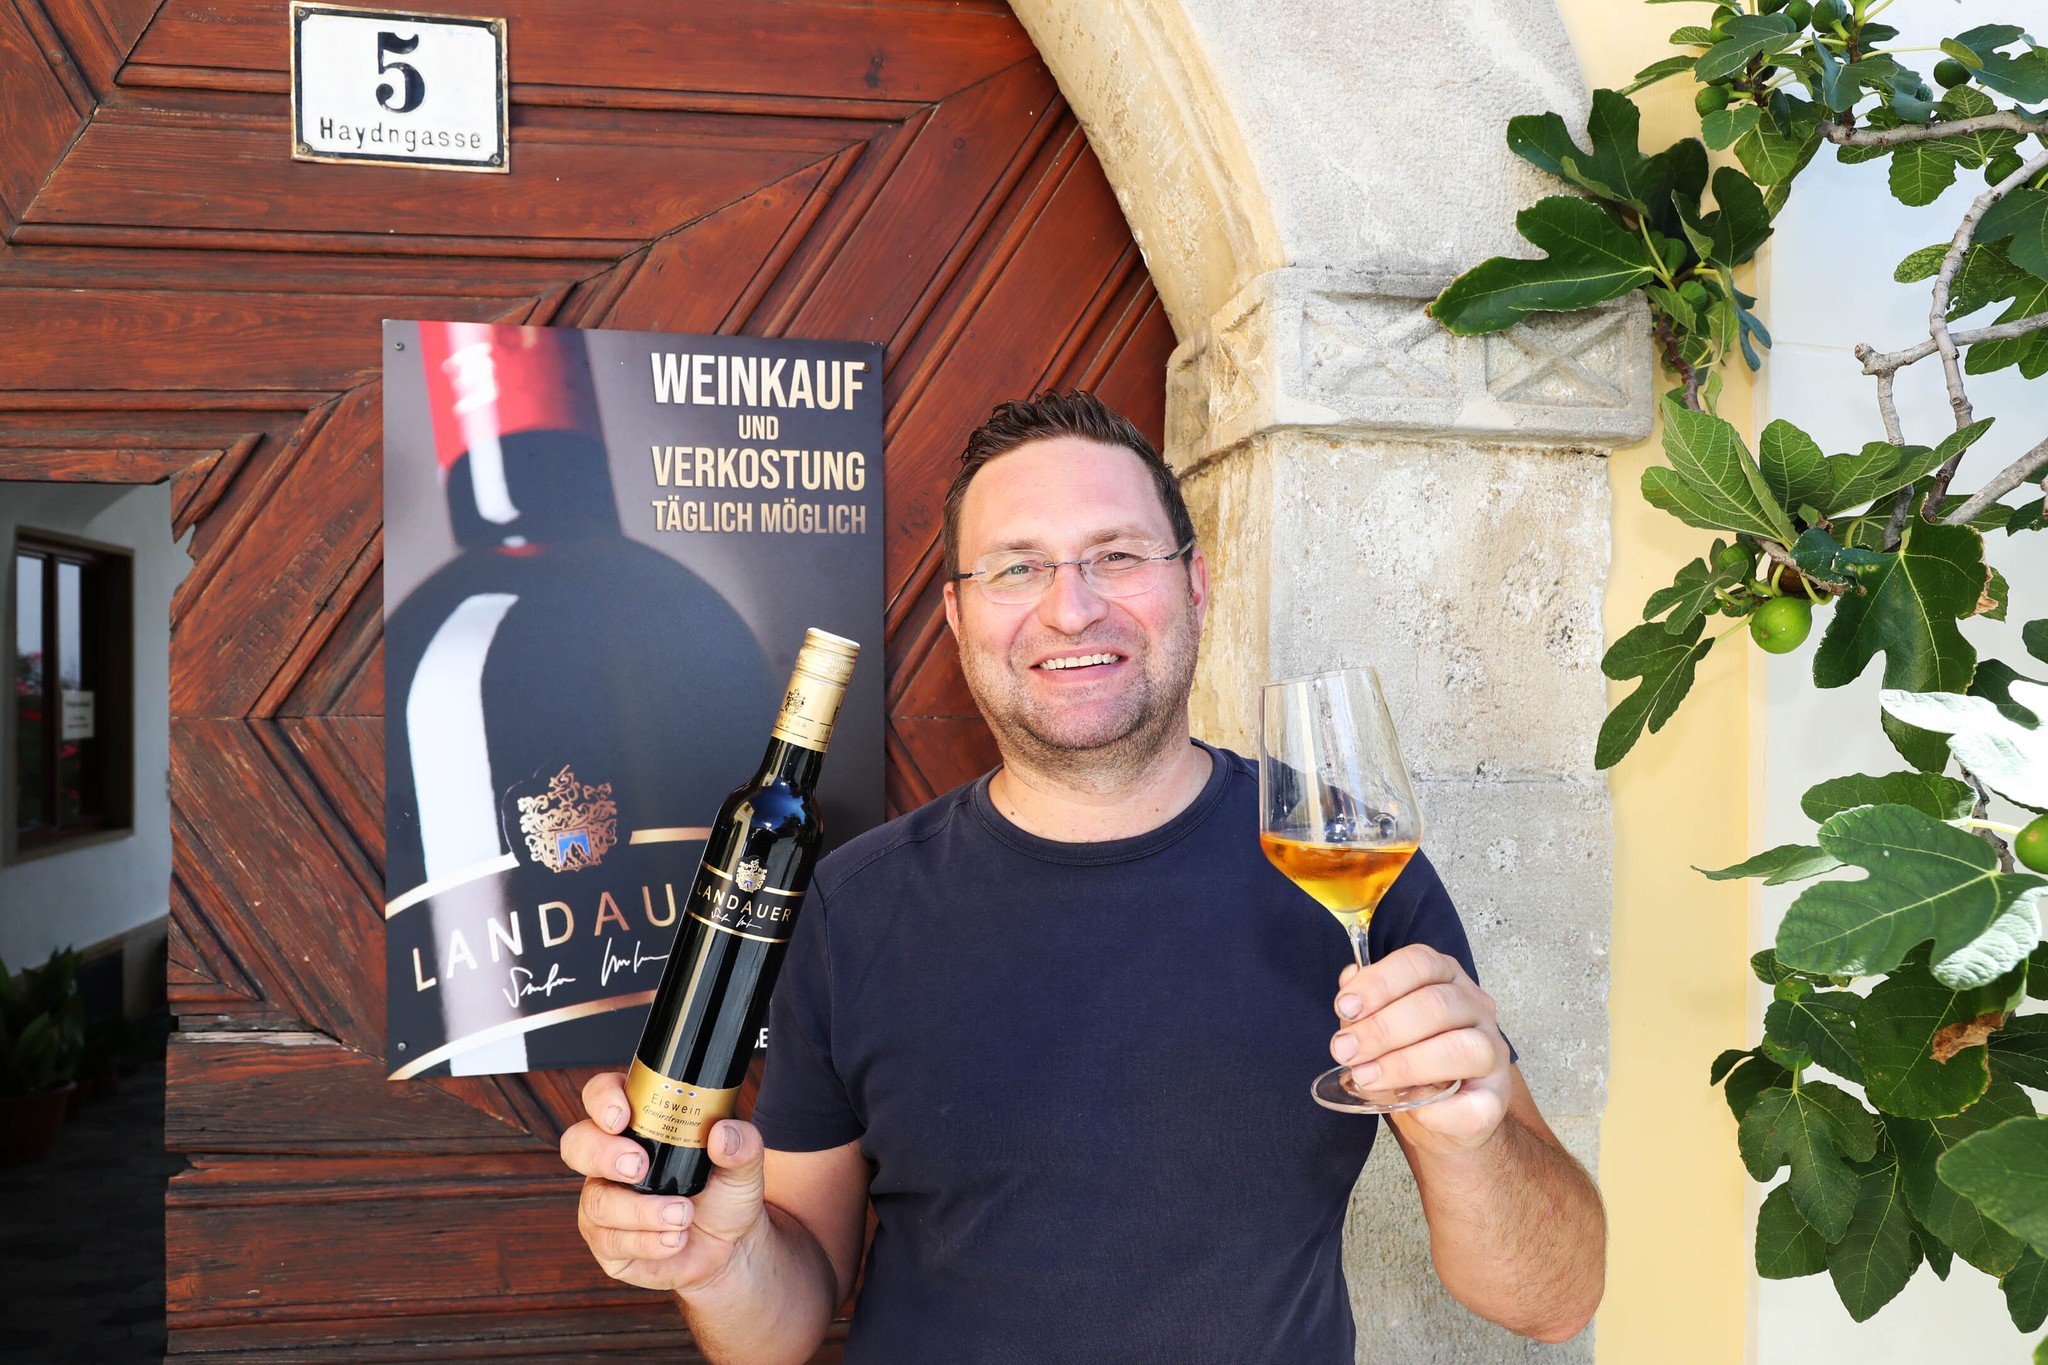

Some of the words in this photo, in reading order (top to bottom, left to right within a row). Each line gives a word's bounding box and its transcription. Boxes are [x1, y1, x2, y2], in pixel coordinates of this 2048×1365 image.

[376, 31, 425, 113] 5
[320, 117, 481, 152] Haydngasse
[651, 352, 866, 410] WEINKAUF
[738, 415, 779, 440] UND
[651, 446, 865, 491] VERKOSTUNG
[652, 495, 752, 533] TÄGLICH
[760, 498, 866, 534] MÖGLICH
[696, 880, 792, 922] LANDAUER
[412, 883, 677, 992] LANDAU
[642, 1105, 701, 1127] Gewürztraminer
[651, 1093, 701, 1117] Eiswein
[662, 1123, 678, 1133] 2021
